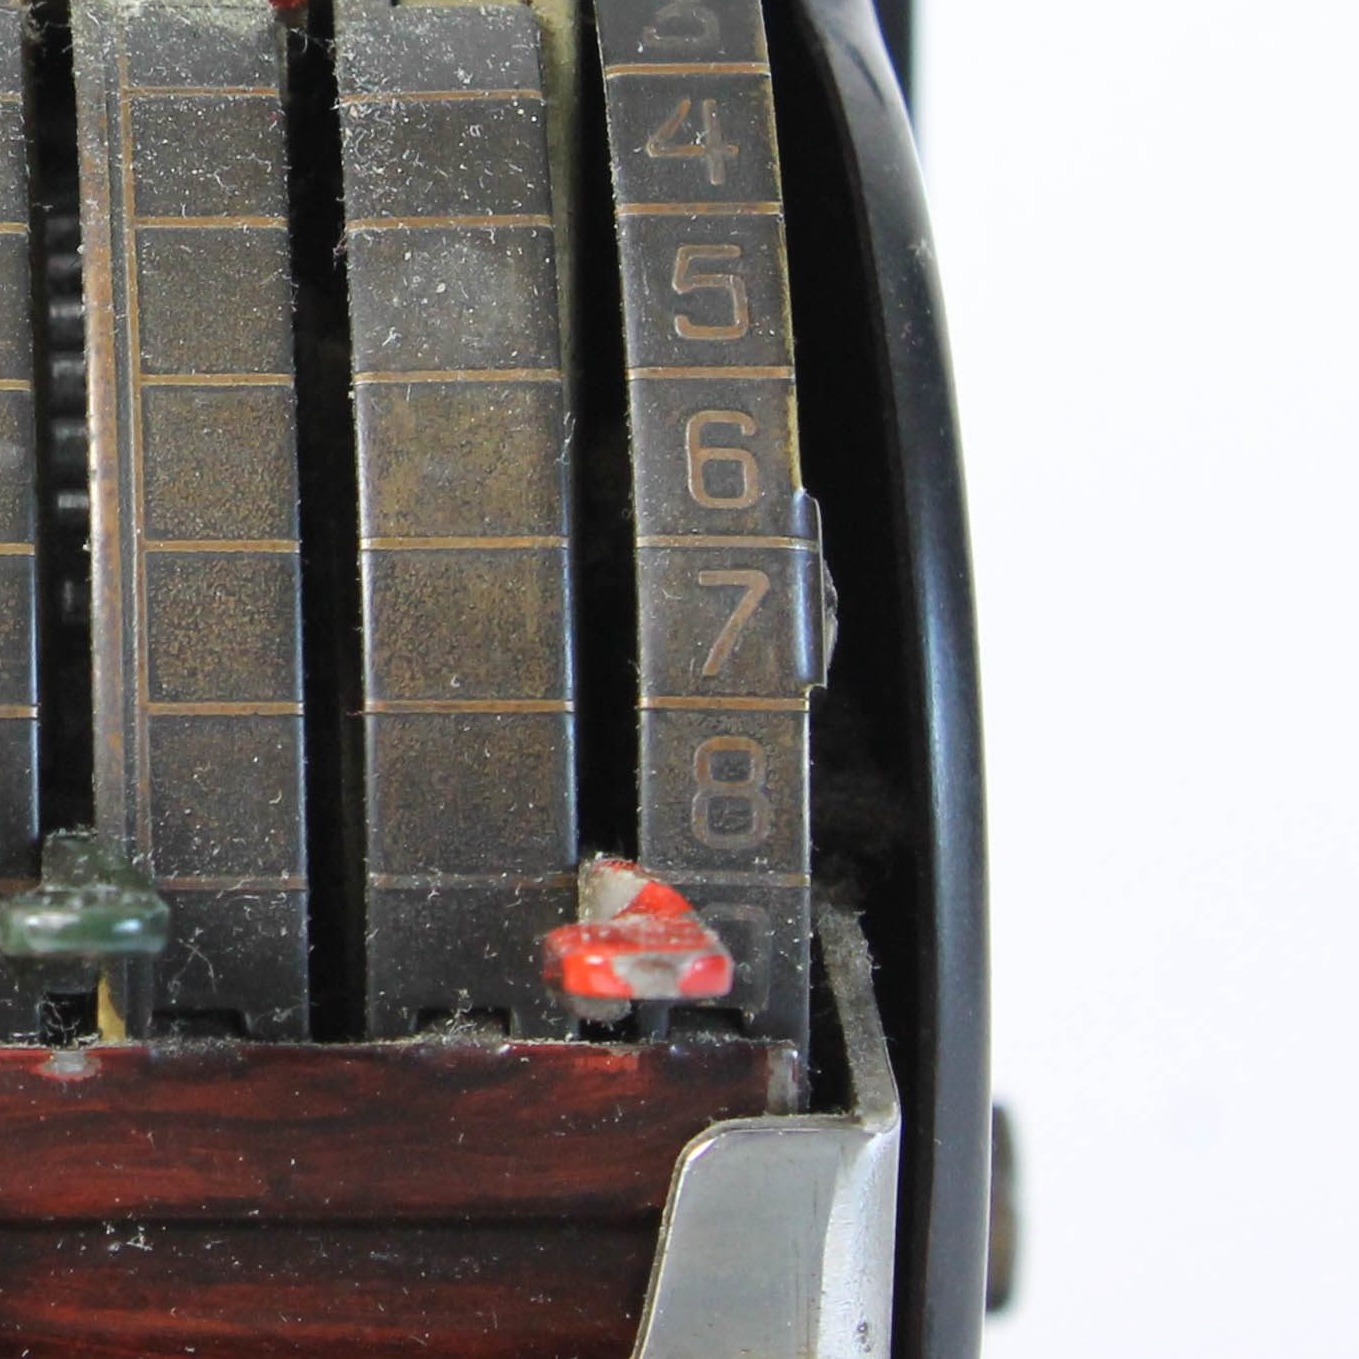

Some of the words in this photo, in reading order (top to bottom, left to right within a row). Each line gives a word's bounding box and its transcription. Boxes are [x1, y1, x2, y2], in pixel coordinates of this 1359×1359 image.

[646, 98, 739, 186] 4
[671, 243, 749, 340] 5
[686, 409, 759, 510] 6
[697, 570, 771, 677] 7
[692, 735, 769, 849] 8
